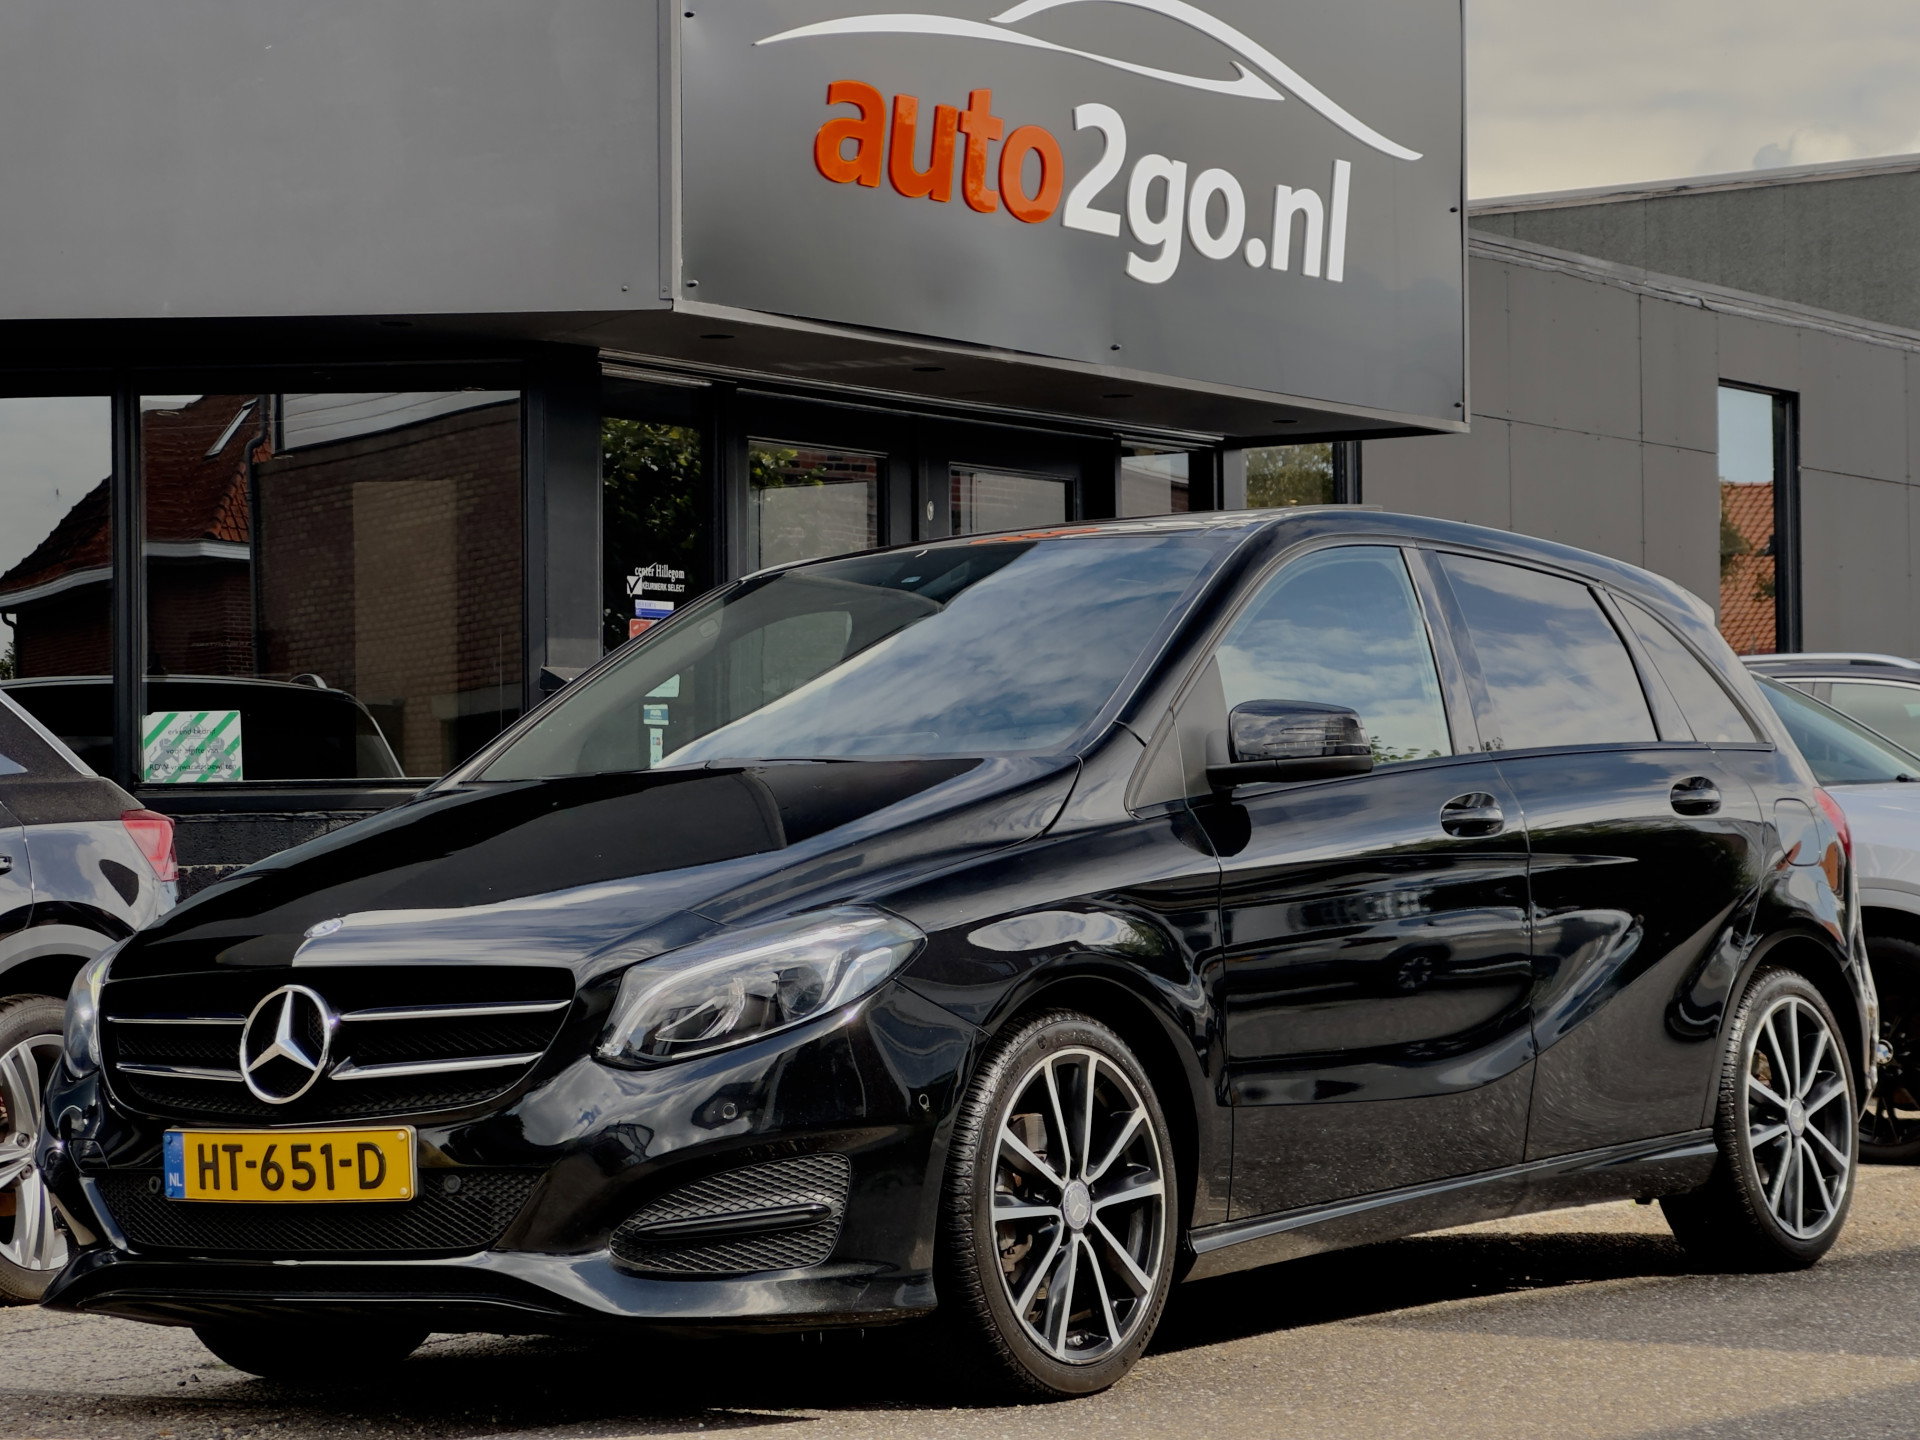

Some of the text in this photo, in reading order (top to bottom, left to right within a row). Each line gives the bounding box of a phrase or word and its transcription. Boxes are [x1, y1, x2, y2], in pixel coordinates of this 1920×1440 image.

[814, 79, 1351, 284] auto2go.nl
[655, 564, 685, 582] Hillegom
[667, 583, 685, 592] SELECT
[169, 1142, 387, 1191] NL HT-651-D
